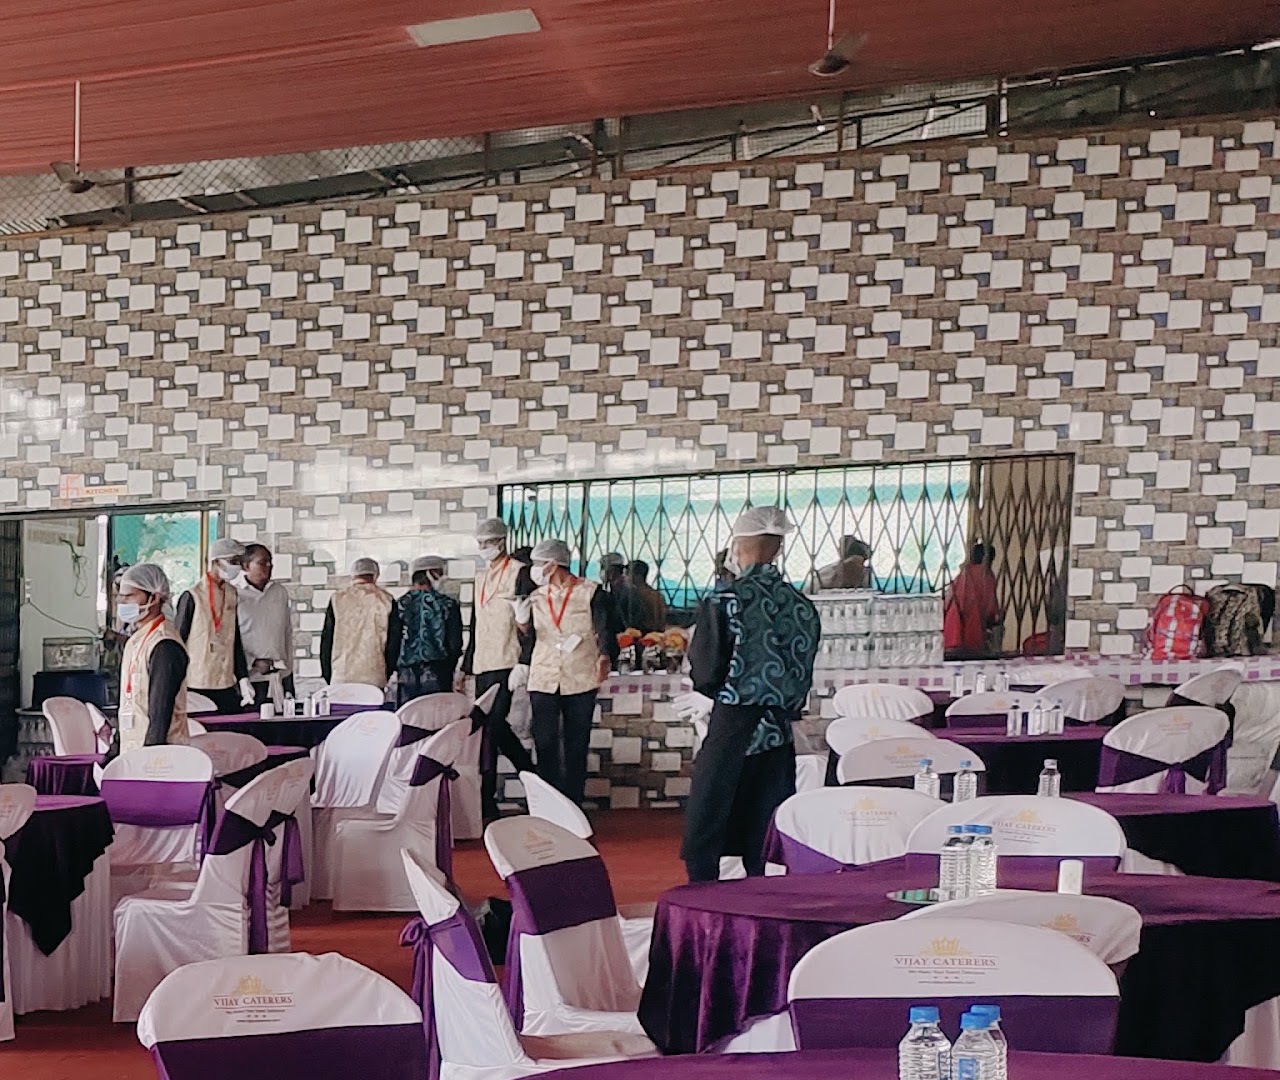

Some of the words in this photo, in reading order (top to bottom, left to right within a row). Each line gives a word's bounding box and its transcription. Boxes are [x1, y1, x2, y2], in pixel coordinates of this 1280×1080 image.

[894, 957, 928, 966] VIJAY
[933, 958, 996, 967] CATERERS
[214, 998, 239, 1006] VIJAY
[242, 996, 293, 1005] CATERERS
